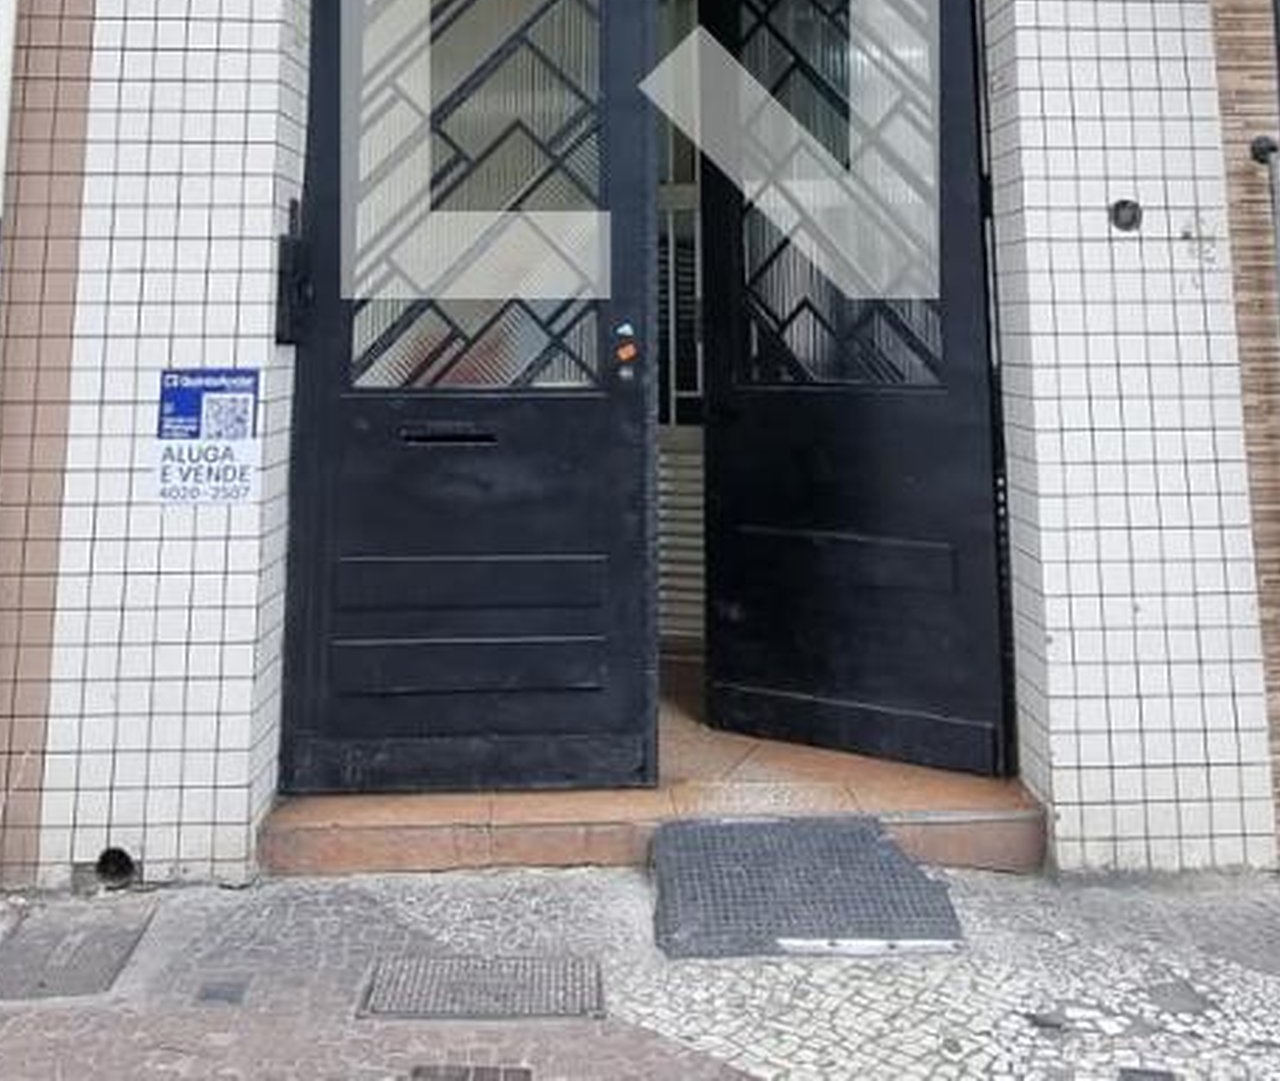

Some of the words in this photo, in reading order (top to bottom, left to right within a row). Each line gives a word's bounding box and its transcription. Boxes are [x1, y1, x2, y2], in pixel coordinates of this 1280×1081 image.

[161, 445, 235, 464] ALUGA
[160, 464, 172, 483] E
[179, 464, 252, 483] VENDE
